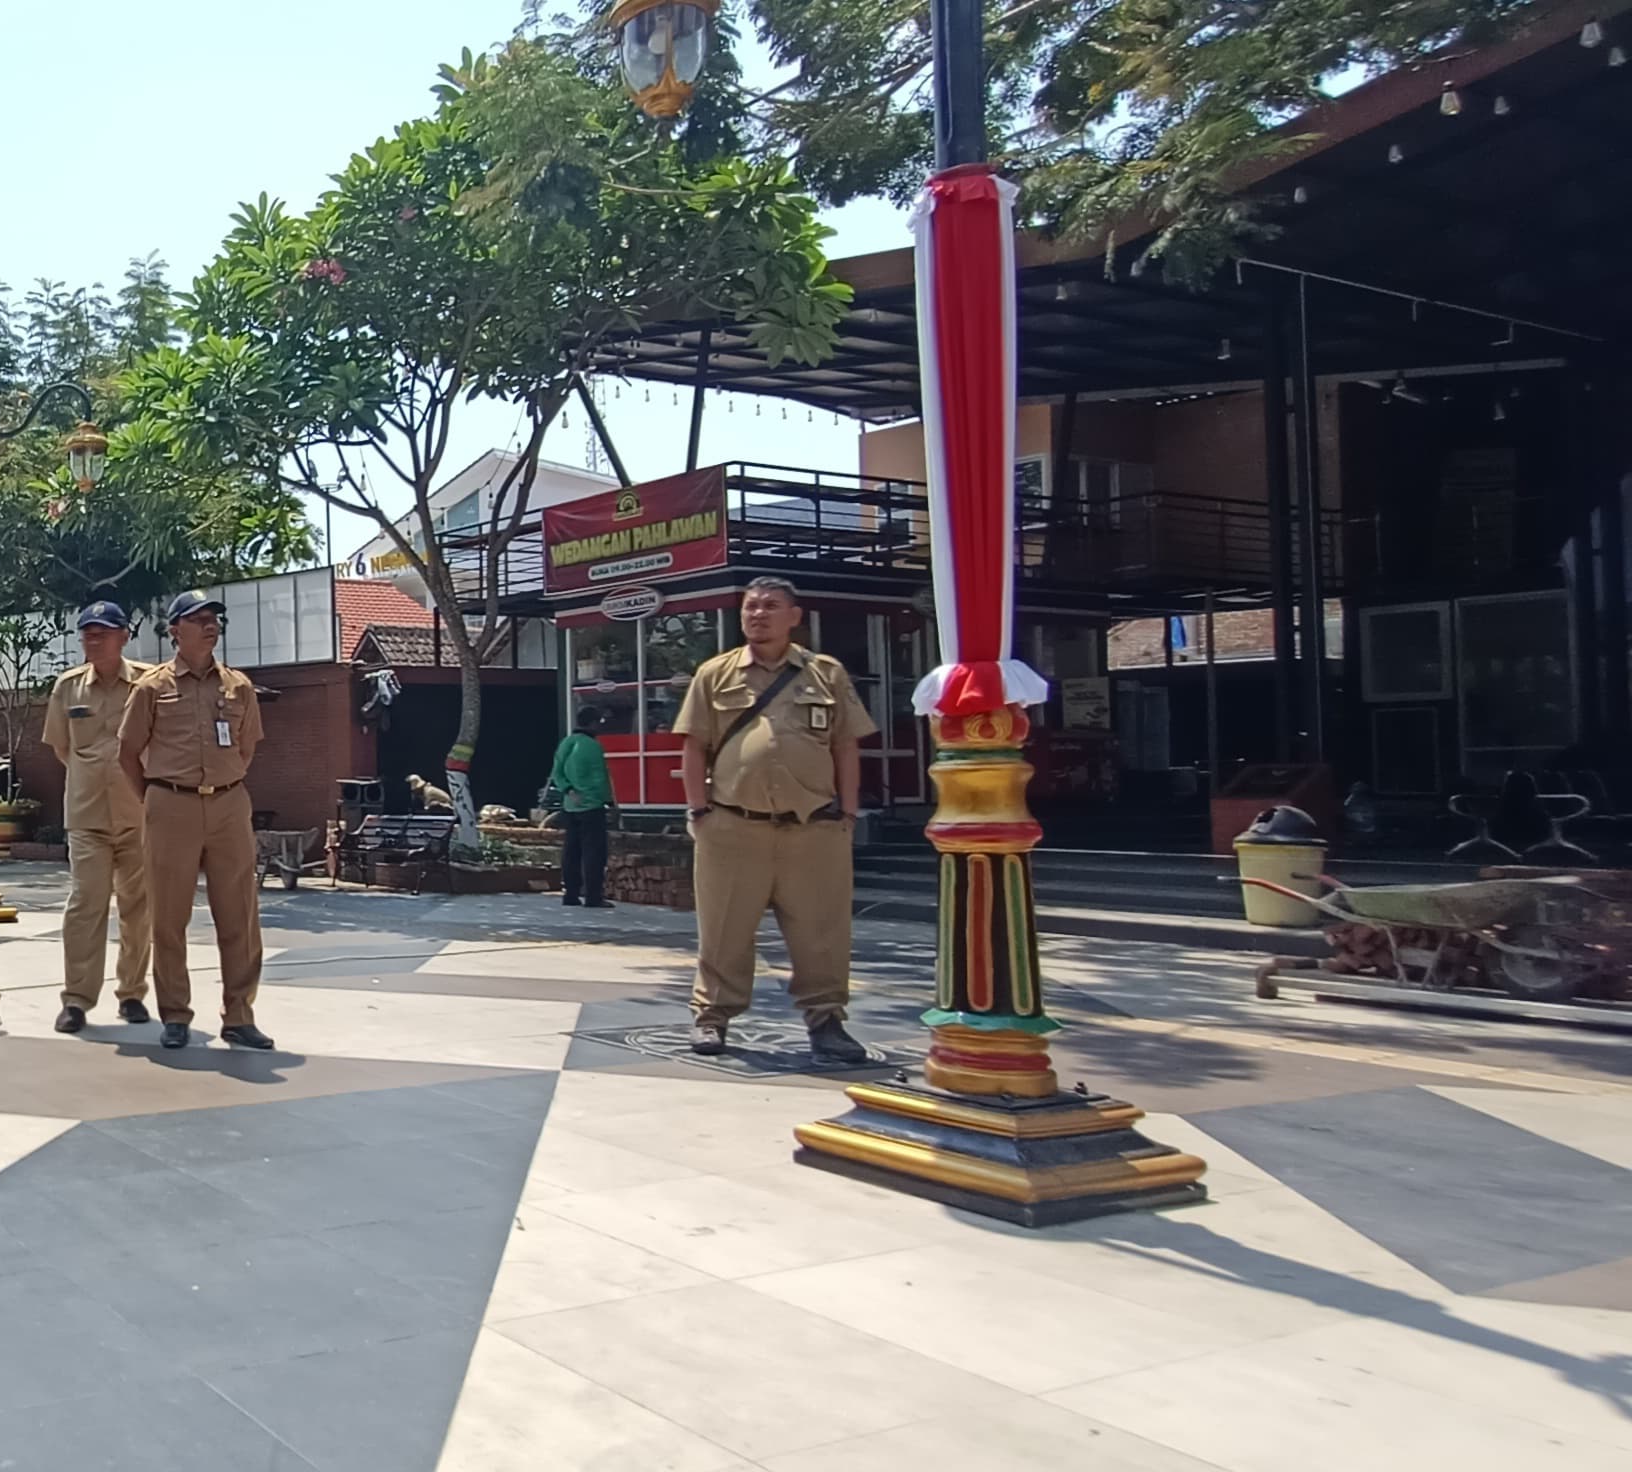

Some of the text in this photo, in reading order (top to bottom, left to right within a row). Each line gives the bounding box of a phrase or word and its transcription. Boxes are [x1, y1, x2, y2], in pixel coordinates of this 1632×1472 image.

[550, 511, 717, 567] WEDANGAN PAHLAWAN
[355, 552, 366, 576] 6
